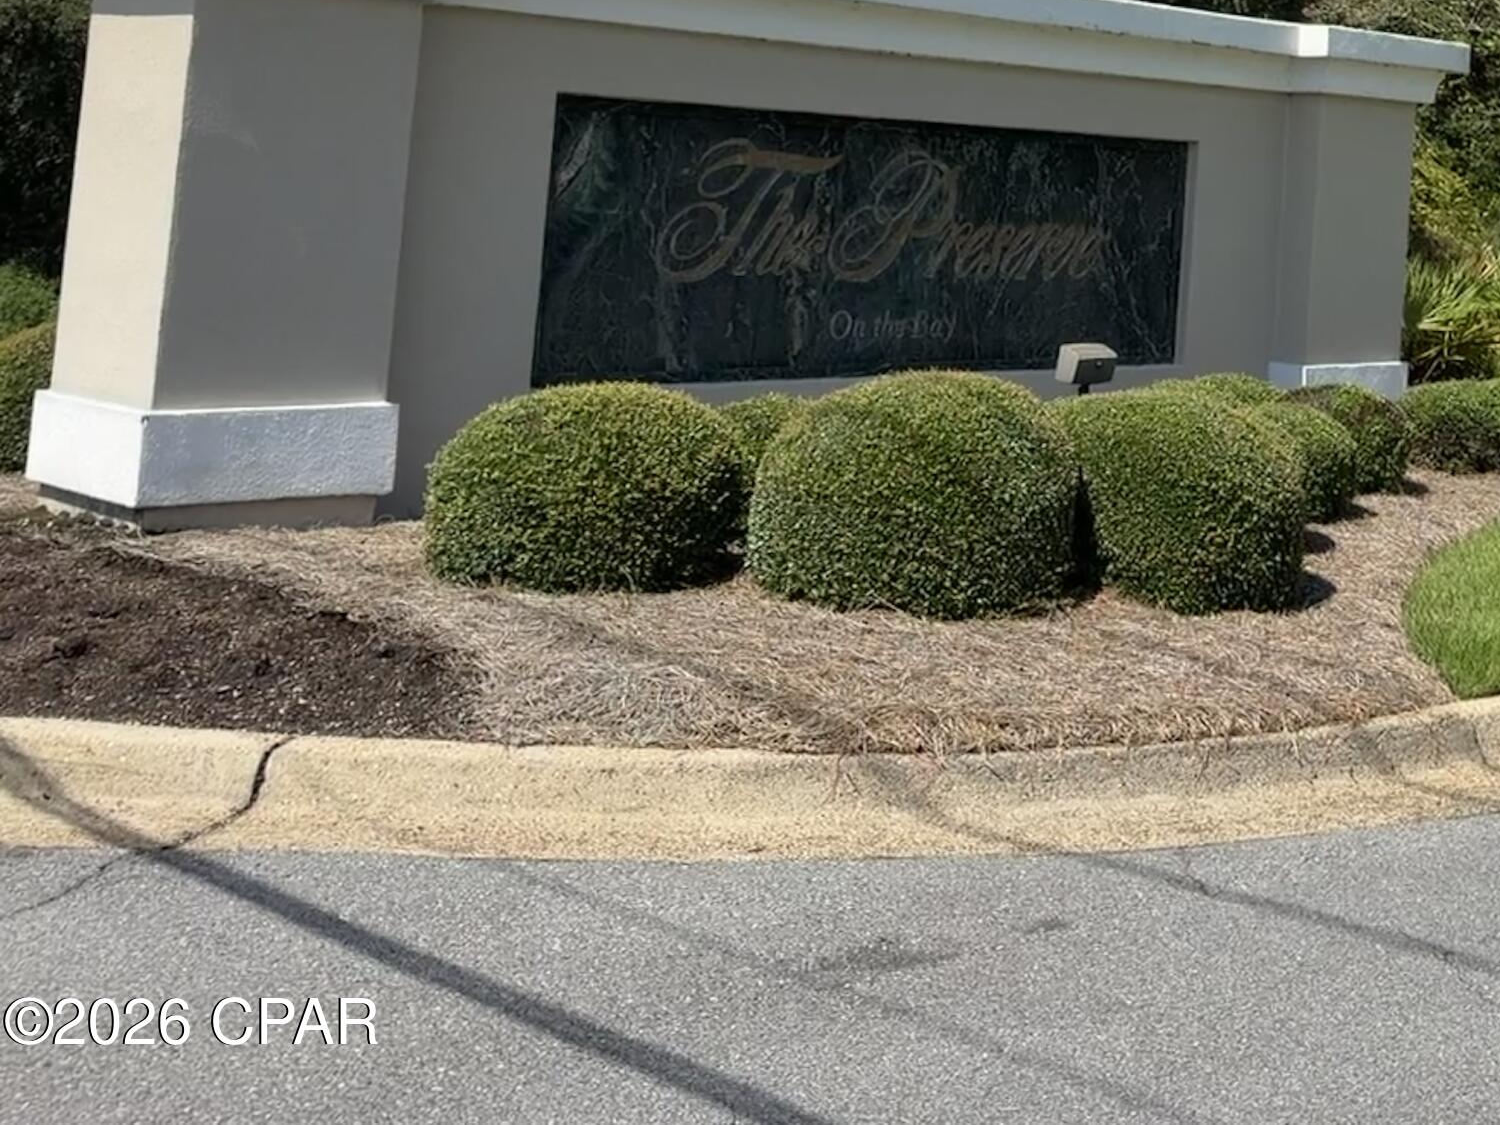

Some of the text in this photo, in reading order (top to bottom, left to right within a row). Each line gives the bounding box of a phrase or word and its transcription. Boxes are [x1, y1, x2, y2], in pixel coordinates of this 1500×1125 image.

[656, 137, 1102, 283] The Preserve
[829, 309, 865, 340] On
[873, 309, 905, 338] the
